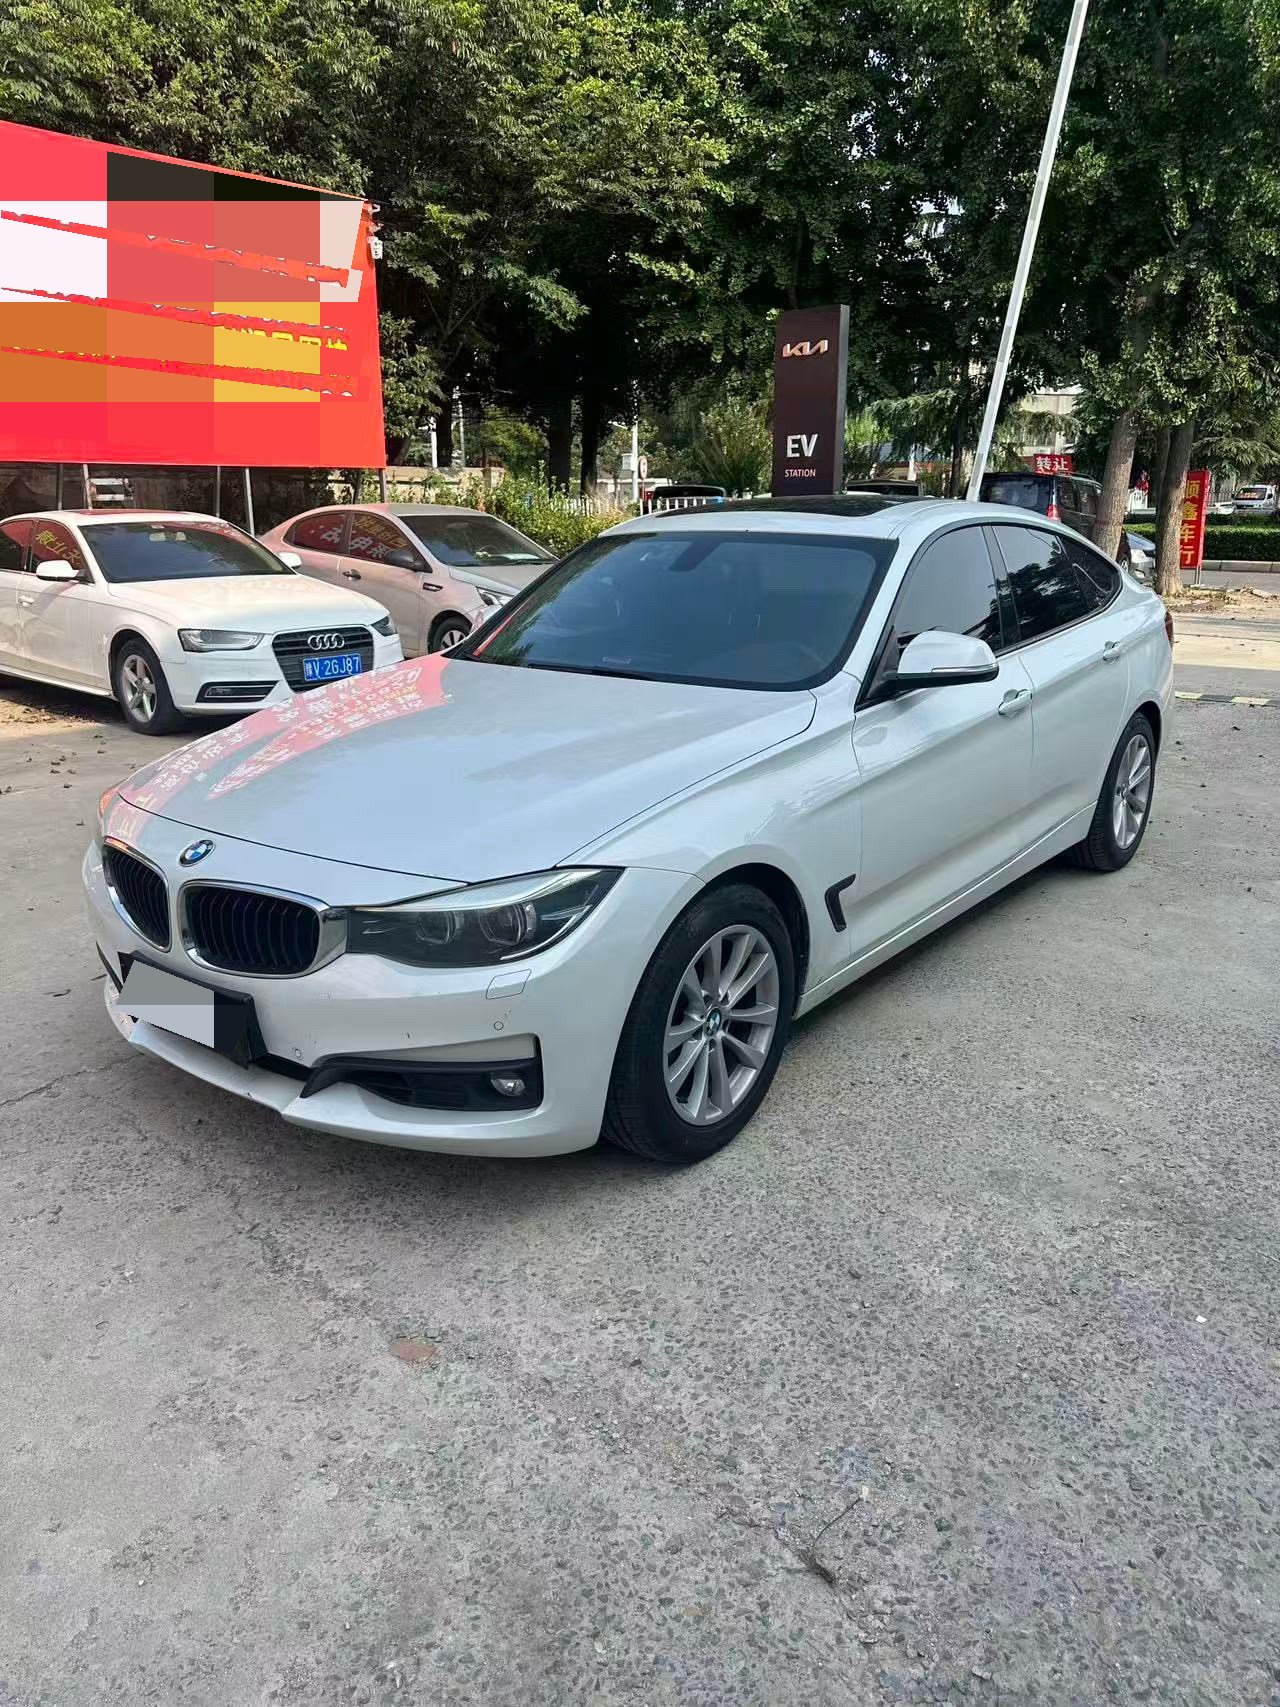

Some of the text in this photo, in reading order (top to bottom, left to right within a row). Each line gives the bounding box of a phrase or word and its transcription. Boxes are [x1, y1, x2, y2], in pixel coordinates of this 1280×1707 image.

[786, 433, 819, 458] EV
[784, 468, 817, 478] STATION
[1035, 456, 1069, 471] 转让
[1180, 479, 1201, 565] 顺鑫车行
